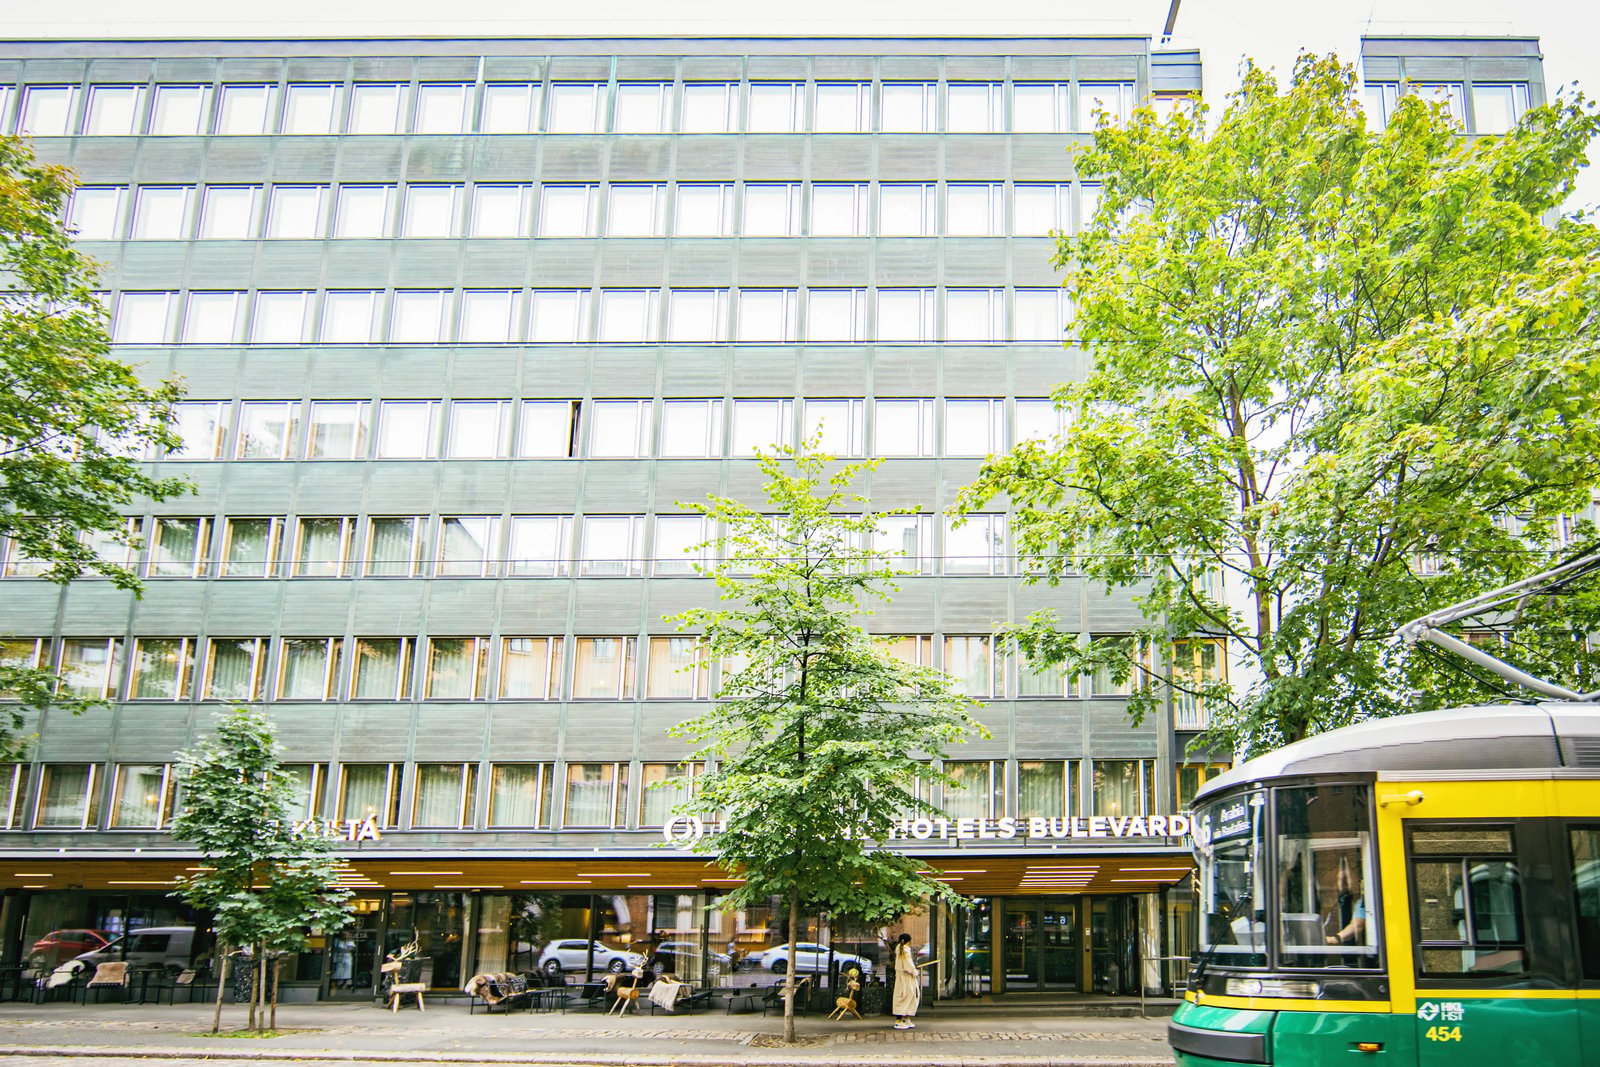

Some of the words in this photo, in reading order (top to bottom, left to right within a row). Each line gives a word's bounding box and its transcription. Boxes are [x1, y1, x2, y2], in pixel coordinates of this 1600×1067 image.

[889, 818, 1016, 840] HOTELS
[1441, 1011, 1464, 1021] HST
[1425, 1026, 1463, 1042] 454
